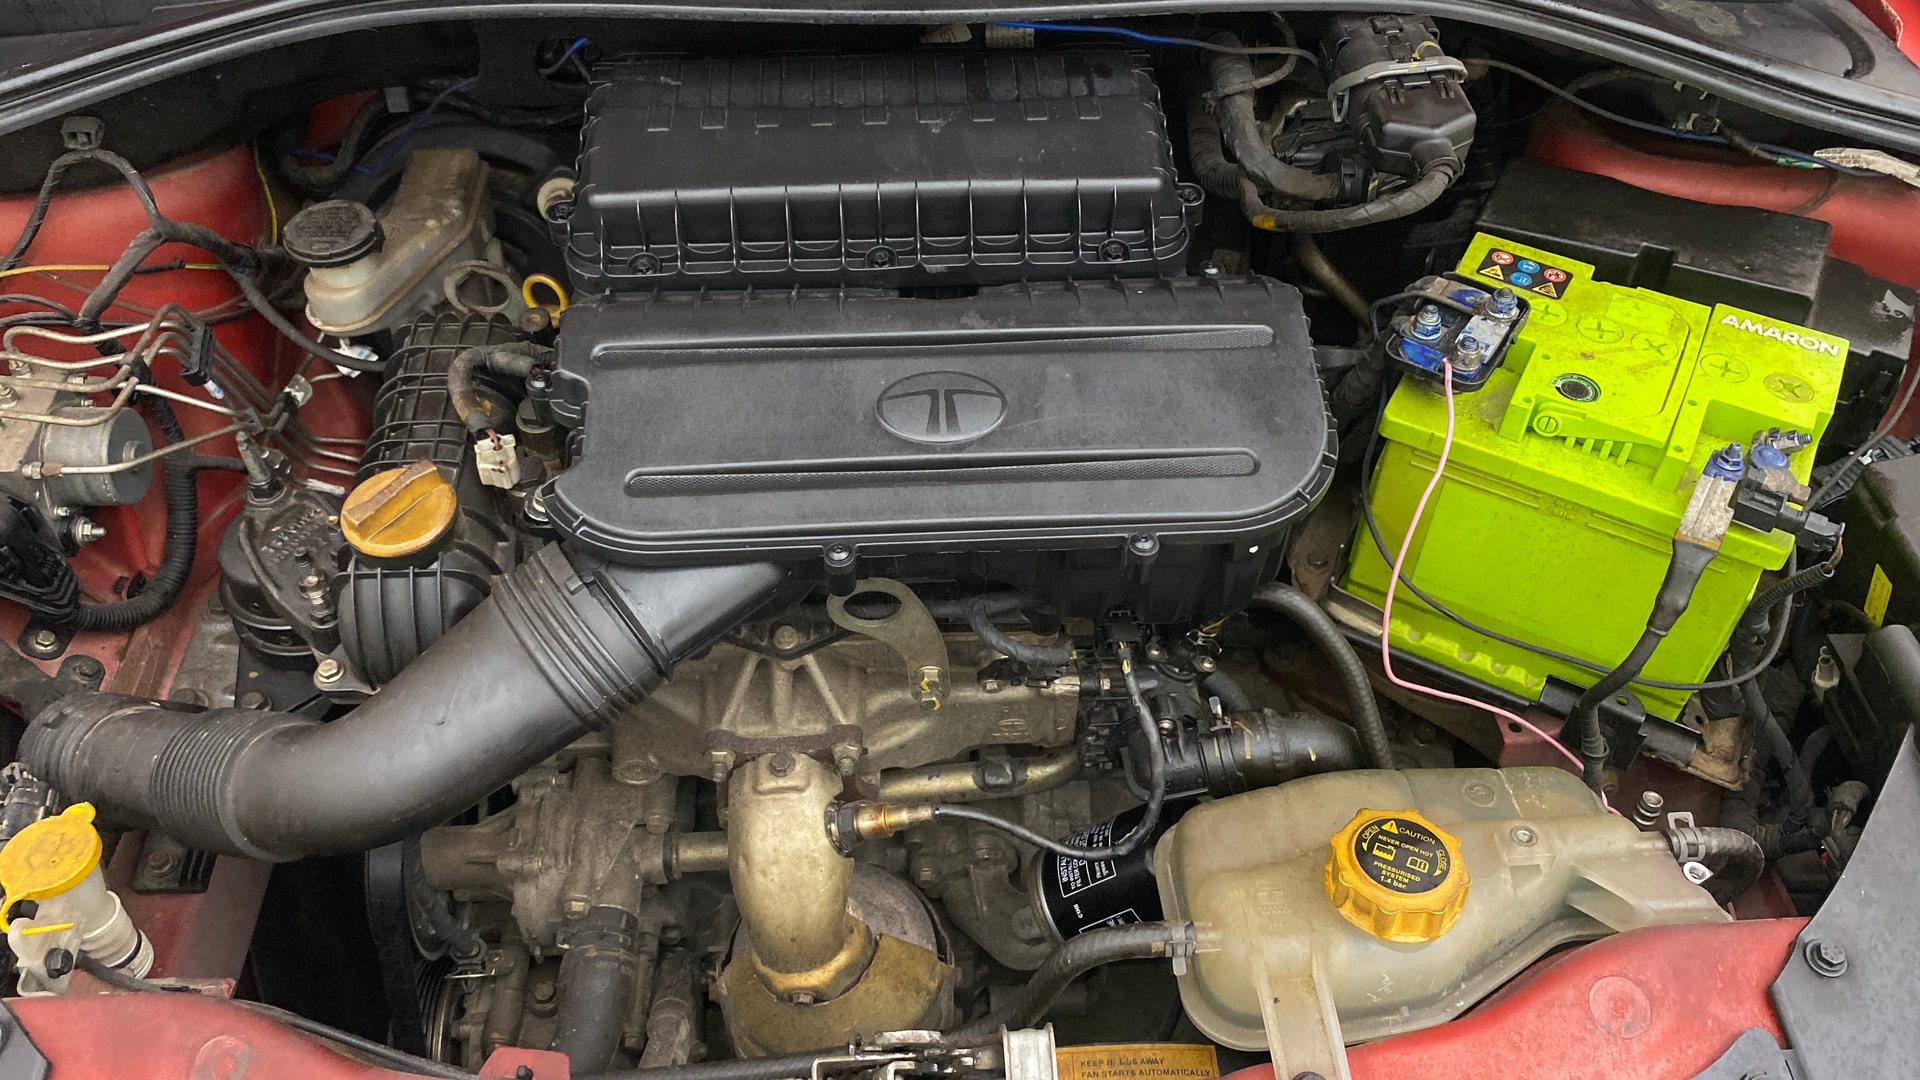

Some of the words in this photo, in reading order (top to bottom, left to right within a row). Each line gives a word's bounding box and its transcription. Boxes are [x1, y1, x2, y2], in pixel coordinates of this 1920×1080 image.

[1720, 314, 1840, 356] AMARON
[1362, 824, 1379, 840] OPEN
[1399, 827, 1436, 845] CAUTION
[1378, 834, 1400, 847] NEVER
[1401, 842, 1420, 853] OPEN
[1420, 848, 1434, 858] HOT
[1438, 849, 1448, 871] CLOSE
[1373, 861, 1421, 882] PRESSURISED
[1381, 870, 1409, 884] SYSTEM
[1380, 876, 1392, 885] 1.4
[1393, 880, 1407, 889] bar
[1080, 1059, 1104, 1068] KEEP
[1140, 1057, 1164, 1065] AWAY
[1081, 1071, 1099, 1079] FAN
[1101, 1069, 1137, 1078] STARTS
[1139, 1068, 1210, 1077] AUTOMATICALLY
